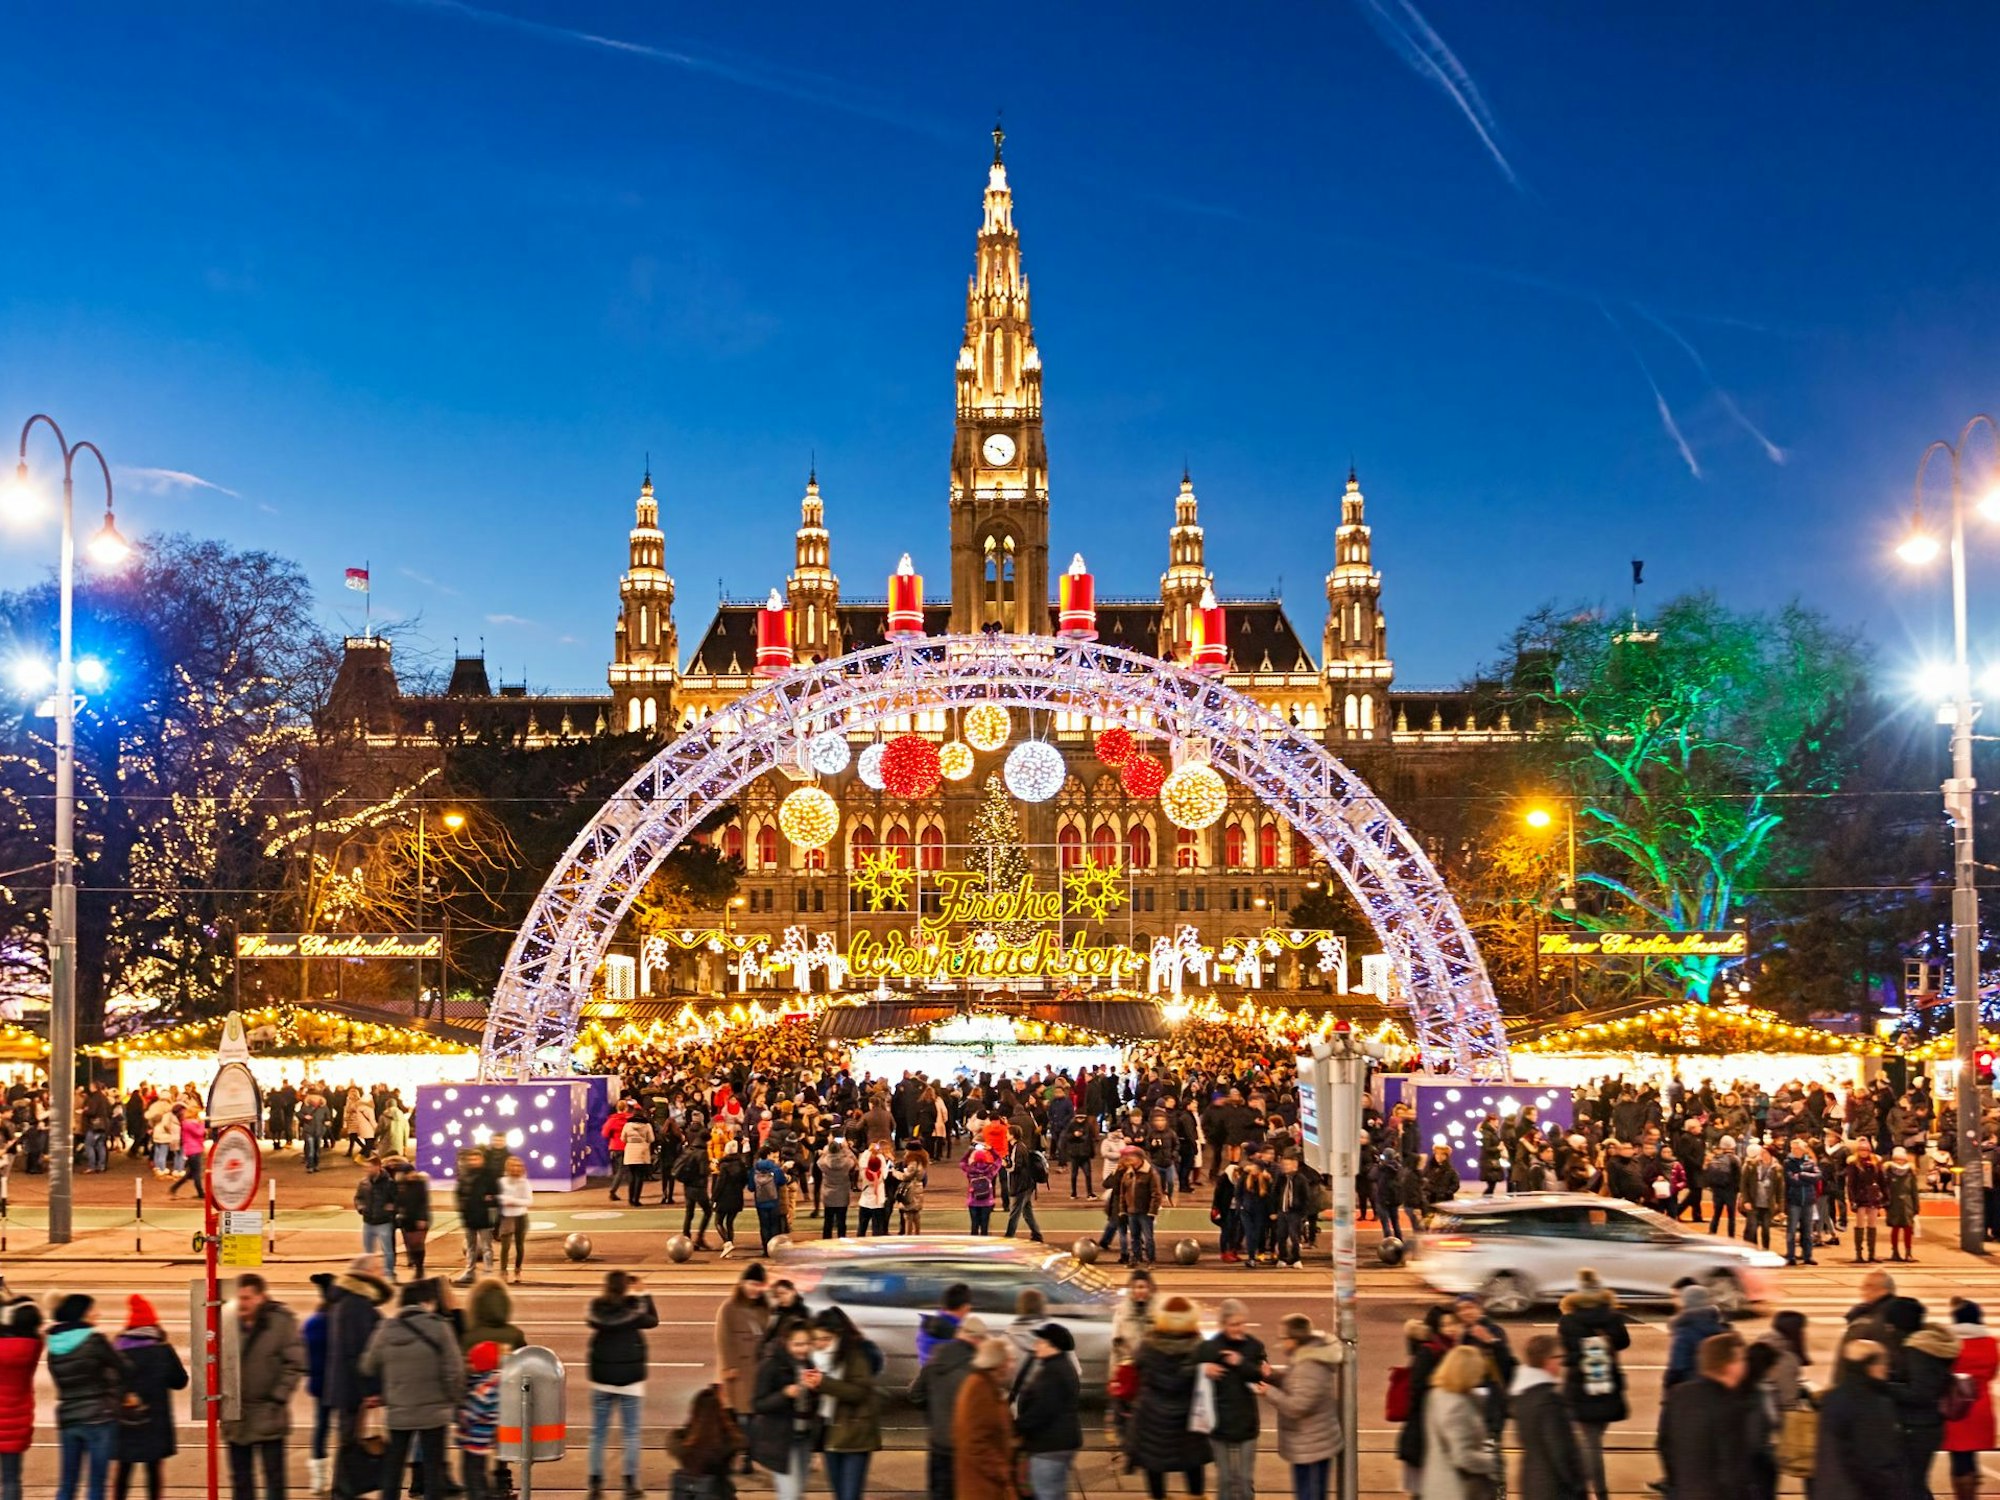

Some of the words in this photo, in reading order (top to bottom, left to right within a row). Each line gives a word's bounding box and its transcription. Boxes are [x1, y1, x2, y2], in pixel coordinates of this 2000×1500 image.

[921, 872, 1062, 930] Frohe
[237, 935, 297, 957] Wiener
[298, 934, 442, 957] Christkindlmarkt
[849, 929, 1134, 977] Weihnachten
[1538, 933, 1600, 954] Wiener
